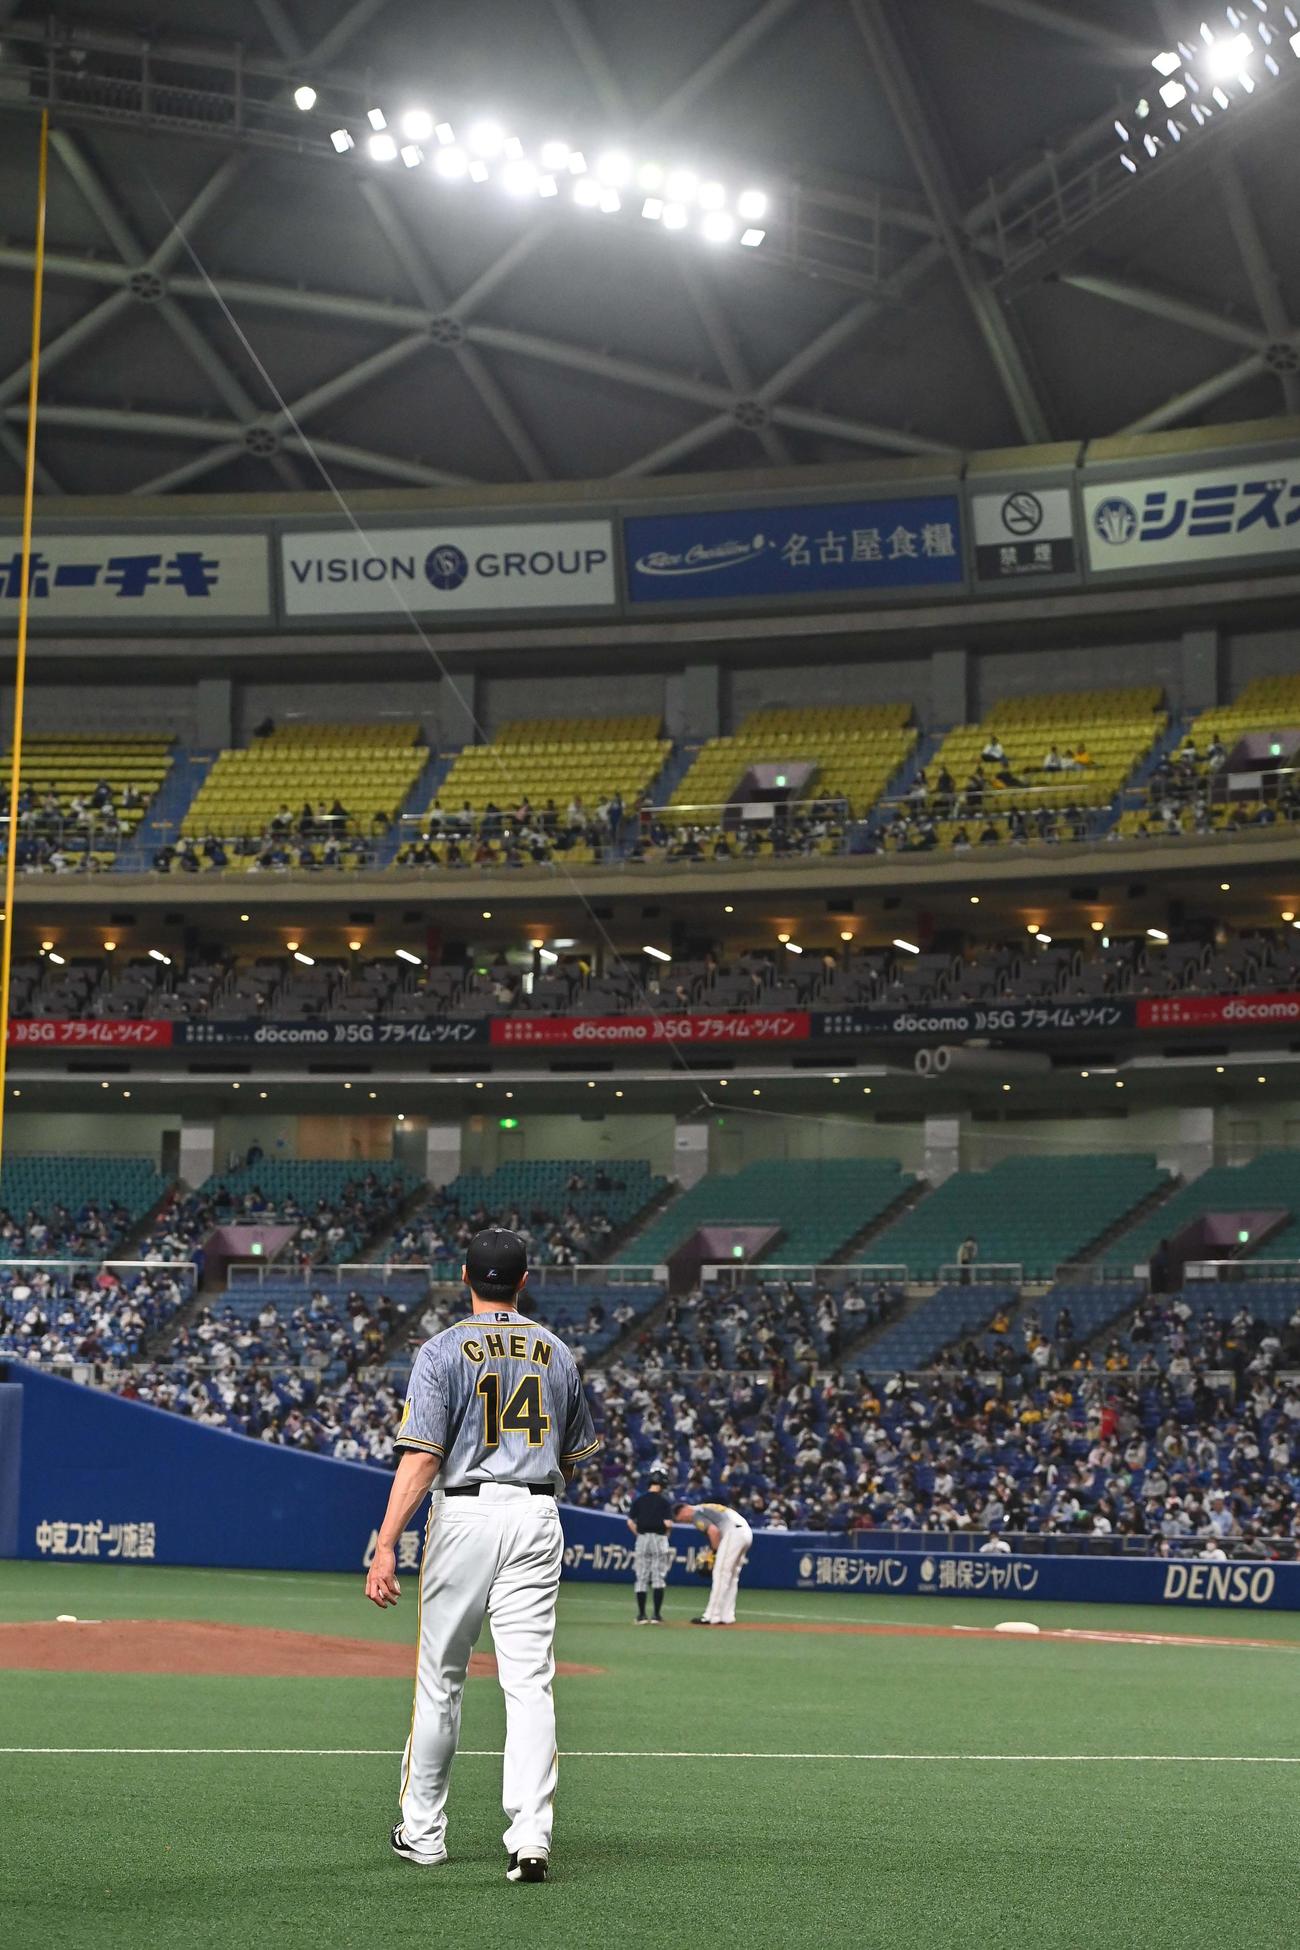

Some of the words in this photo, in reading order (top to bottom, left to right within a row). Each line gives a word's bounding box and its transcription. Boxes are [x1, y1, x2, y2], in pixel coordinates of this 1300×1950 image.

[1140, 477, 1300, 541] シミズ
[781, 522, 957, 566] 名古屋食糧
[0, 552, 220, 598] ホーチキ
[290, 556, 415, 584] VISION
[476, 549, 607, 579] GROUP
[893, 1013, 969, 1032] docomo
[1222, 1001, 1299, 1019] docomo
[254, 1025, 329, 1043] docomo
[572, 1021, 647, 1039] docomo
[462, 1333, 553, 1367] CHEN
[476, 1372, 551, 1448] 14
[36, 1519, 155, 1558] 中京スポーツ施設
[817, 1556, 908, 1587] 損保ジャパン
[939, 1560, 1039, 1592] 損保ジャパン
[1163, 1564, 1276, 1604] DENSO
